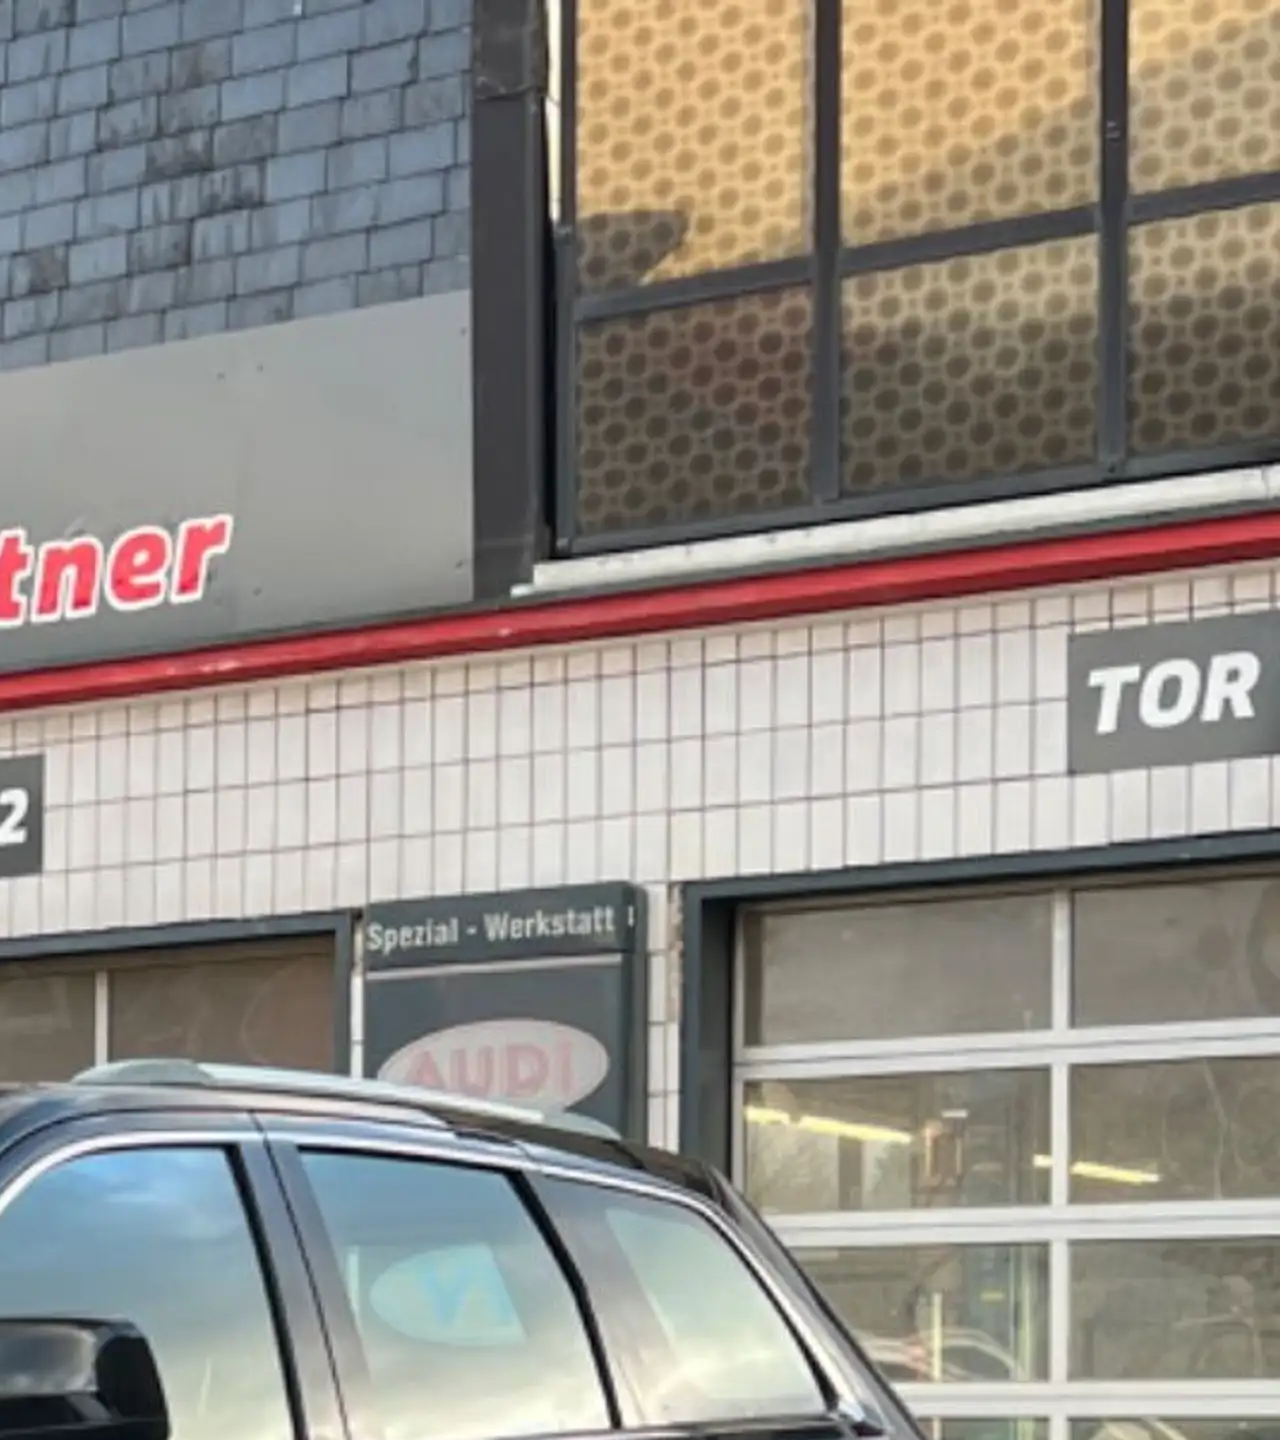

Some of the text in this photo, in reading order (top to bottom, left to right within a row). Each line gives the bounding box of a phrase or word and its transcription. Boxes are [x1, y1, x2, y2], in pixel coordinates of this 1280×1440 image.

[1088, 651, 1261, 735] TOR
[367, 917, 459, 954] Spezial
[483, 906, 615, 942] Werkstatt
[405, 1030, 576, 1098] AUDI
